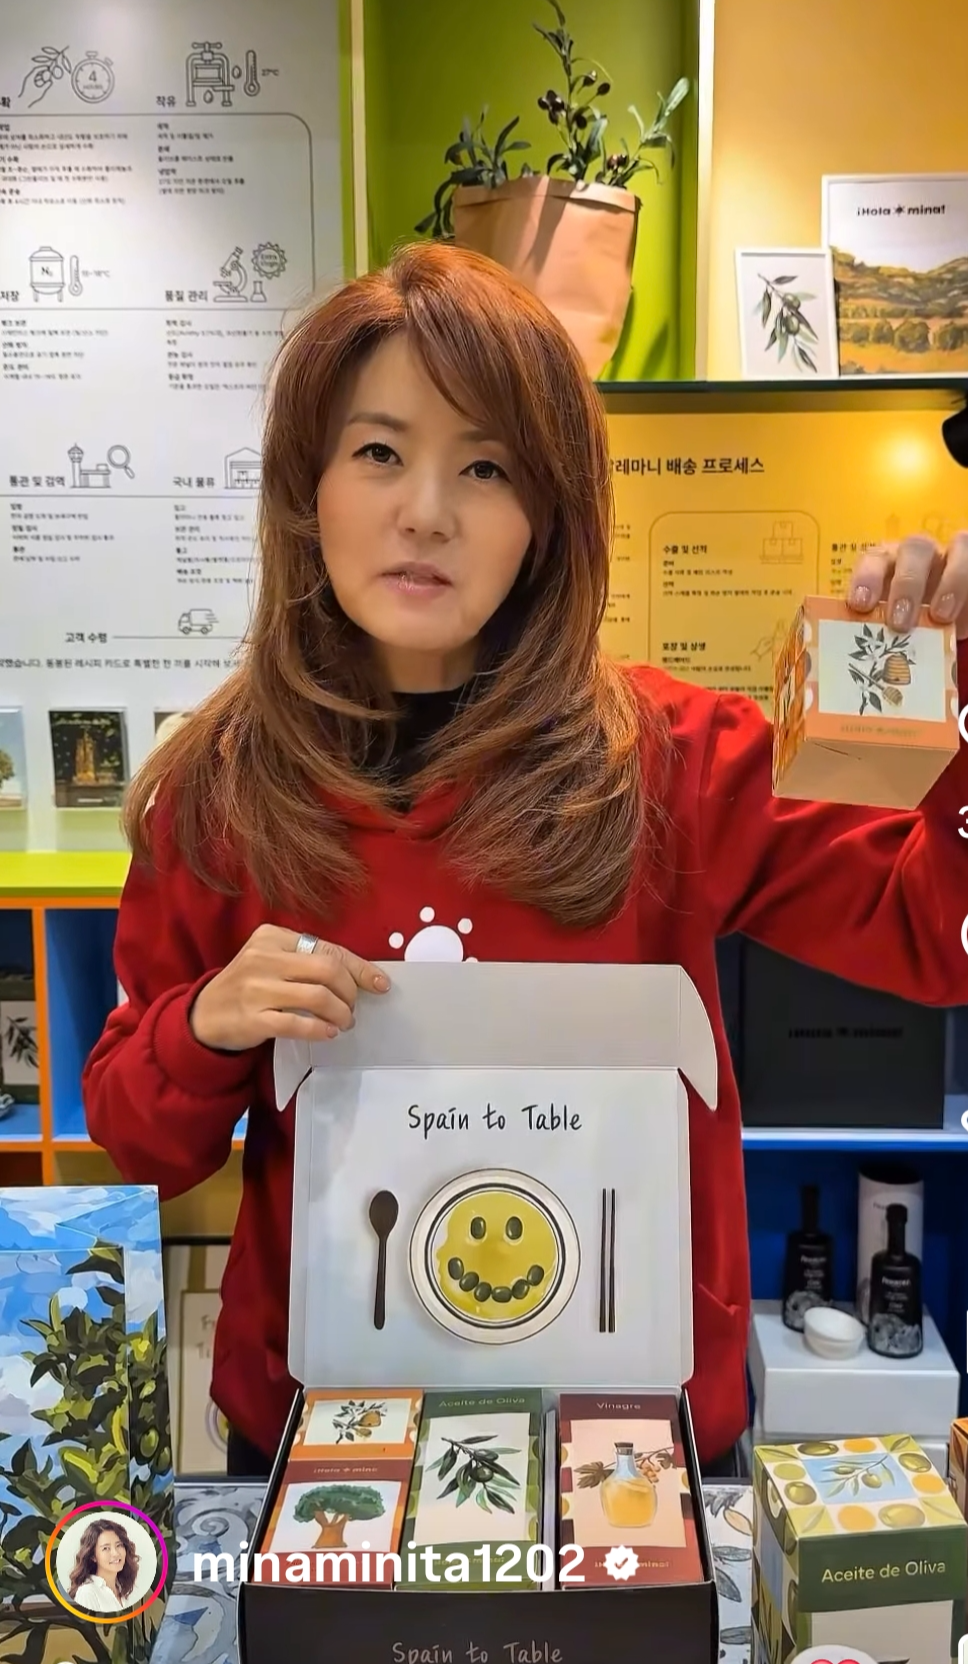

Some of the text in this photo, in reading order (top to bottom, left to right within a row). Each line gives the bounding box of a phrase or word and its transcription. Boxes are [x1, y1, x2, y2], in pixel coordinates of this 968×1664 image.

[88, 70, 97, 82] 4
[156, 95, 176, 107] 착유
[165, 290, 208, 302] 품질 관리
[666, 457, 697, 476] 배송
[702, 457, 765, 475] 프로세스
[9, 475, 65, 487] 통관 및 검역
[173, 476, 215, 488] 국내 물류
[663, 545, 679, 554] 수출
[681, 545, 689, 554] 및
[65, 632, 108, 644] 고객 수령
[680, 642, 688, 651] 및
[46, 658, 73, 669] 동봉된
[75, 658, 102, 669] 레시피
[105, 658, 130, 669] 카드로
[134, 658, 160, 669] 특별한
[163, 658, 172, 669] 한
[195, 658, 220, 669] 시작해
[482, 1103, 506, 1130] to
[521, 1103, 582, 1131] Table
[438, 1396, 525, 1408] Aceite de Oliva
[596, 1401, 641, 1411] Vinagre
[821, 1559, 946, 1584] Aceite de Oliva
[465, 1641, 488, 1663] to
[503, 1640, 563, 1663] Table
